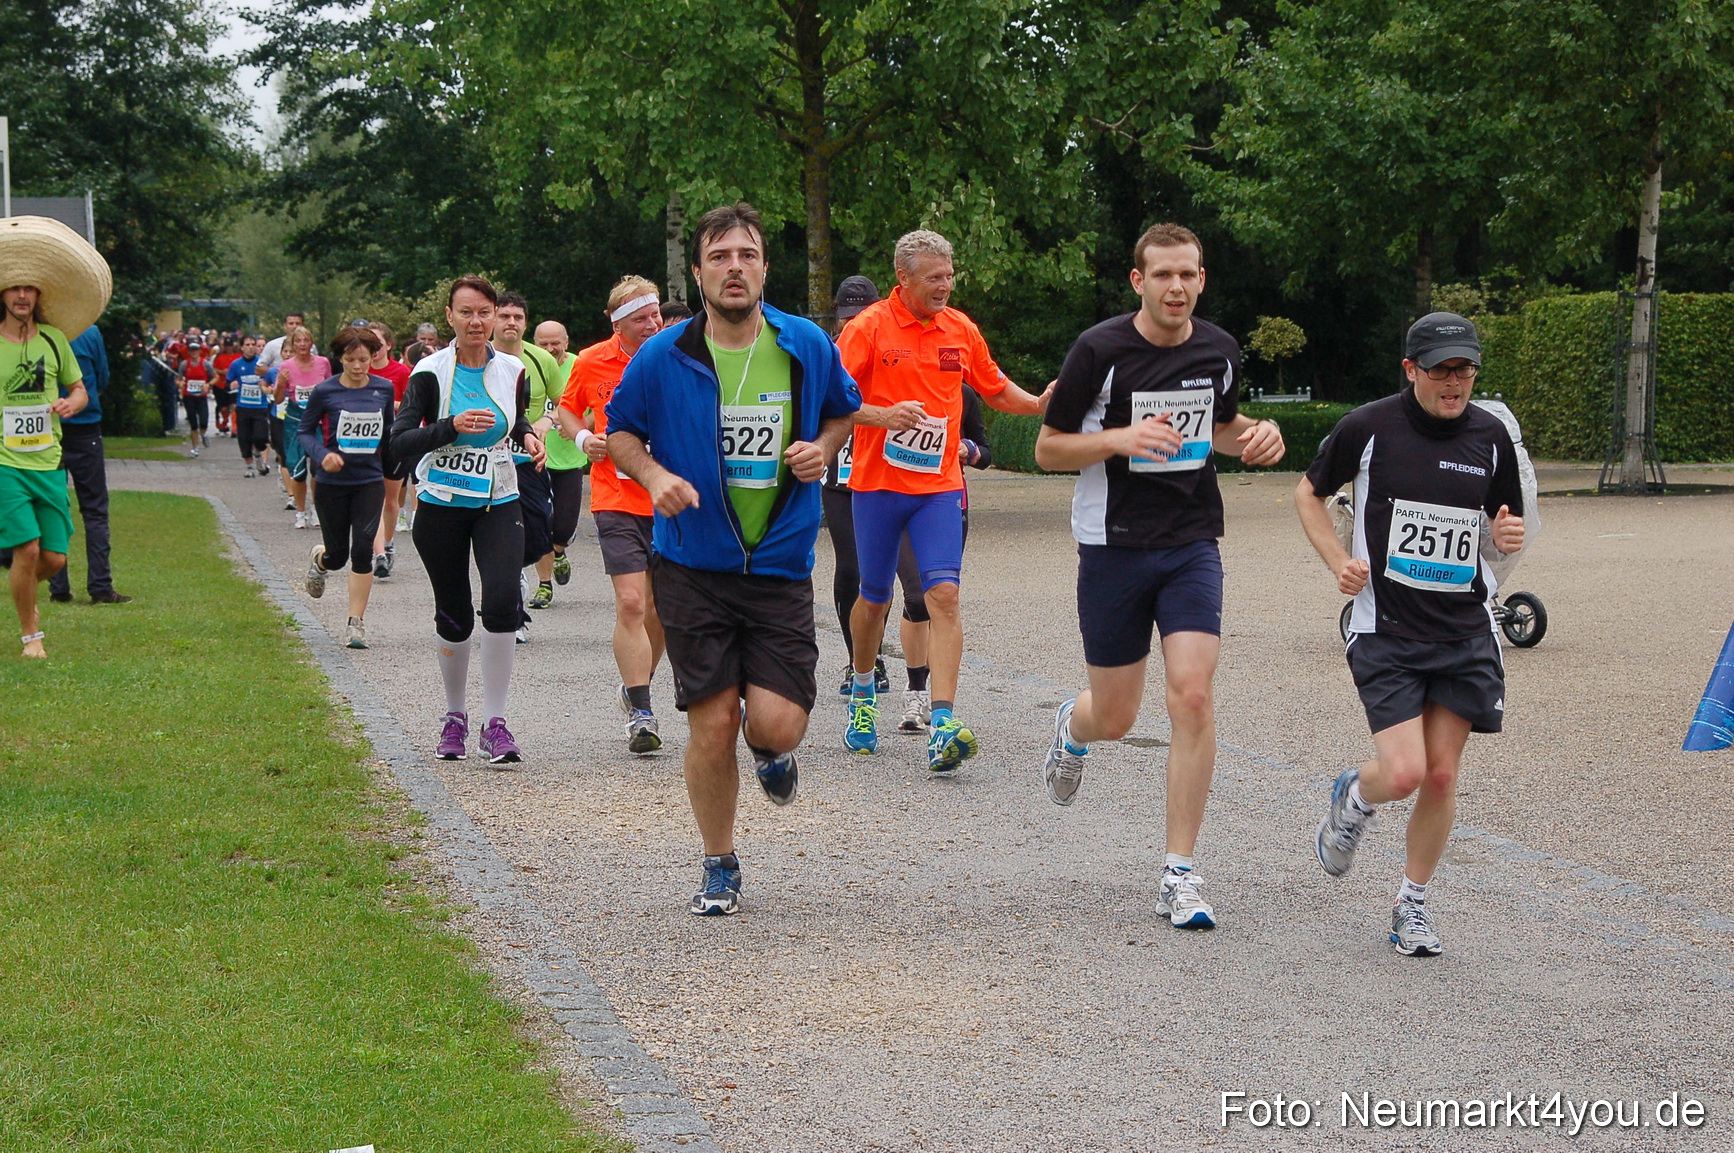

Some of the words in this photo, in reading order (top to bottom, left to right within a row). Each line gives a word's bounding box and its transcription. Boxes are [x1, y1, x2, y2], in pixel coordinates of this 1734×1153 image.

[1135, 399, 1162, 408] PARTL
[1165, 398, 1201, 407] Neumarkt
[15, 416, 44, 434] 280
[724, 415, 766, 423] Neumarkt
[342, 422, 380, 437] 2402
[20, 437, 40, 446] Armin
[892, 427, 944, 452] 2704
[896, 449, 930, 466] Gerhard
[1447, 462, 1486, 476] PFLEIDERER
[444, 475, 471, 488] nicole
[1395, 508, 1426, 520] PARTL
[1428, 513, 1469, 526] Neumarkt
[1398, 523, 1472, 562] 2516
[1409, 563, 1455, 581] Rüdiger
